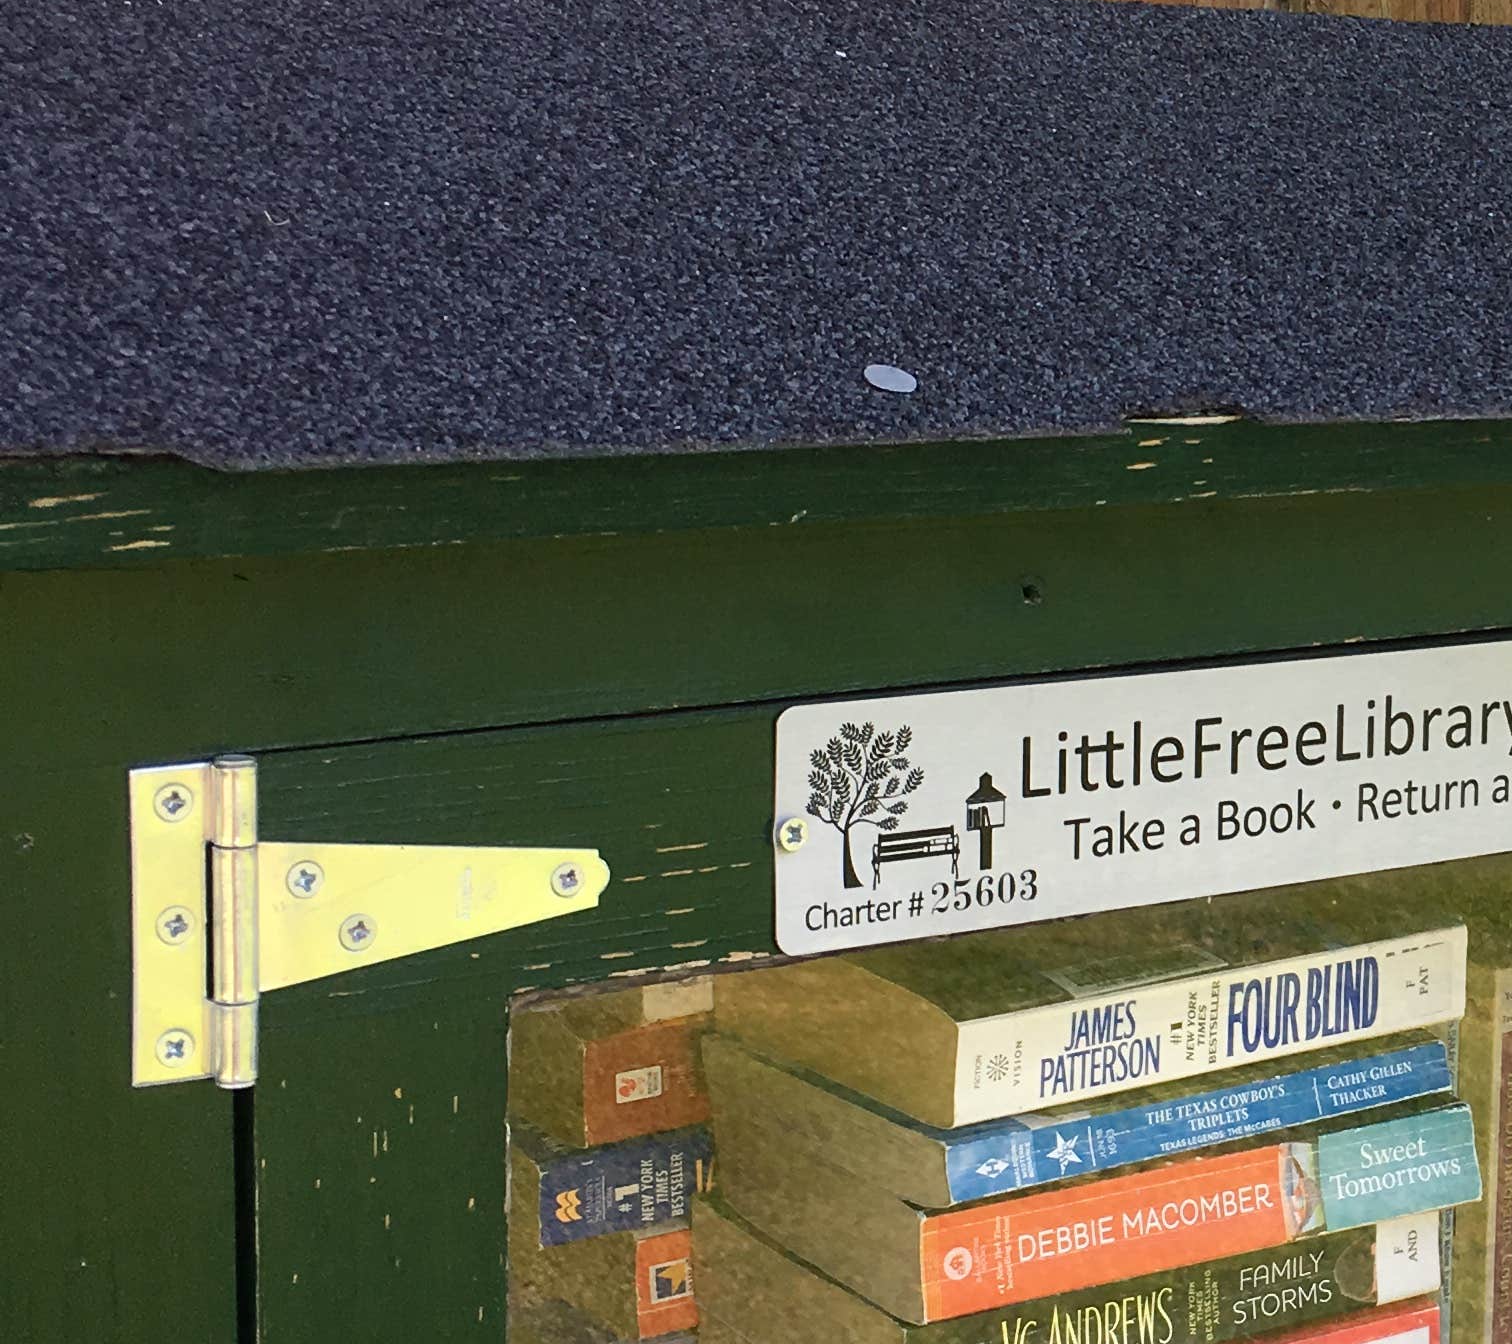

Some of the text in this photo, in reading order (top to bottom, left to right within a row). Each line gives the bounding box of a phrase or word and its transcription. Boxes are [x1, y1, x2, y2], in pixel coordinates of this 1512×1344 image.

[1065, 816, 1165, 861] Take
[1180, 824, 1201, 847] a
[1218, 790, 1316, 840] Book
[1357, 772, 1480, 823] Return
[1491, 779, 1510, 802] a
[1419, 966, 1429, 995] PAT
[1064, 1000, 1136, 1051] JAMES
[1185, 991, 1198, 1061] NEW YORK
[1197, 1004, 1207, 1046] TIMES
[1208, 980, 1221, 1064] BESTSELLER
[1226, 972, 1301, 1057] FOUR
[1305, 955, 1379, 1041] BLIND
[1012, 1040, 1022, 1086] VISION
[1040, 1034, 1161, 1098] PATTERSON
[1327, 1060, 1413, 1090] CATHY GILLEN
[1145, 1083, 1286, 1125] THE TEXAS COWBOY'S
[1329, 1084, 1387, 1106] THACKER
[1188, 1107, 1249, 1132] TRIPLETS
[1159, 1138, 1187, 1151] TEXAS
[1360, 1137, 1428, 1169] Sweet
[614, 1183, 640, 1213] #1
[640, 1159, 654, 1222] NEW YORK
[655, 1169, 669, 1204] TIMES
[670, 1151, 684, 1217] BESTSELLER
[1329, 1157, 1462, 1201] Tomorrows
[1018, 1215, 1115, 1263] DEBBIE
[1123, 1183, 1274, 1239] MACOMBER
[1408, 1229, 1418, 1262] AND
[1239, 1250, 1325, 1292] FAMILY
[1188, 1280, 1197, 1335] NEW YORK
[1204, 1269, 1214, 1342] BESTSELLING
[1232, 1279, 1333, 1325] STORMS
